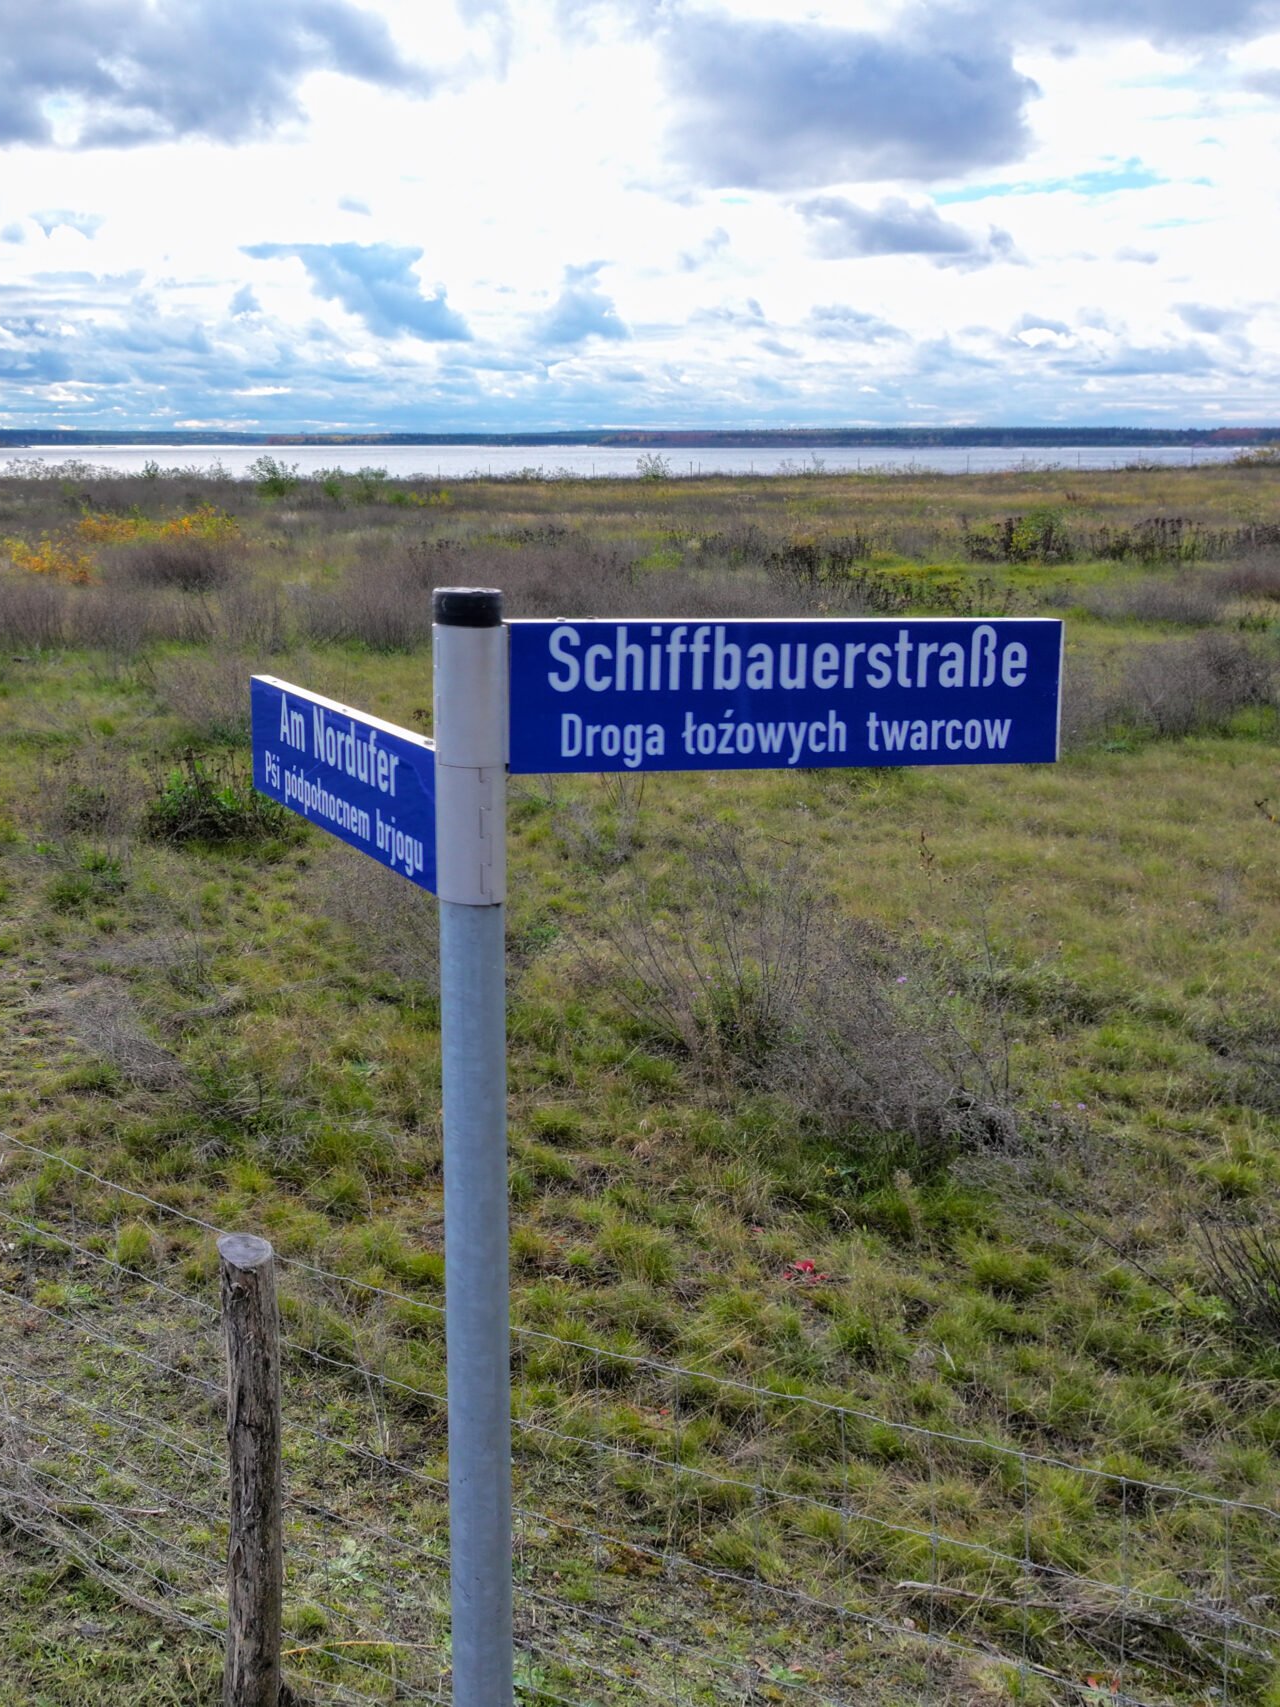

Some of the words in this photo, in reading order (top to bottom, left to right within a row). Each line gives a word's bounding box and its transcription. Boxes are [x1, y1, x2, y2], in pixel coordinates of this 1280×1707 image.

[549, 625, 1027, 692] Schiffbauerstraße
[280, 692, 306, 753] Am
[312, 705, 399, 797] Nordufer
[561, 713, 665, 767] Droga
[682, 709, 846, 765] łoźowych
[866, 712, 1012, 751] twarcow
[265, 750, 281, 790] Pśi
[284, 764, 370, 841] pódpołnocnem
[376, 808, 424, 877] brjogu
